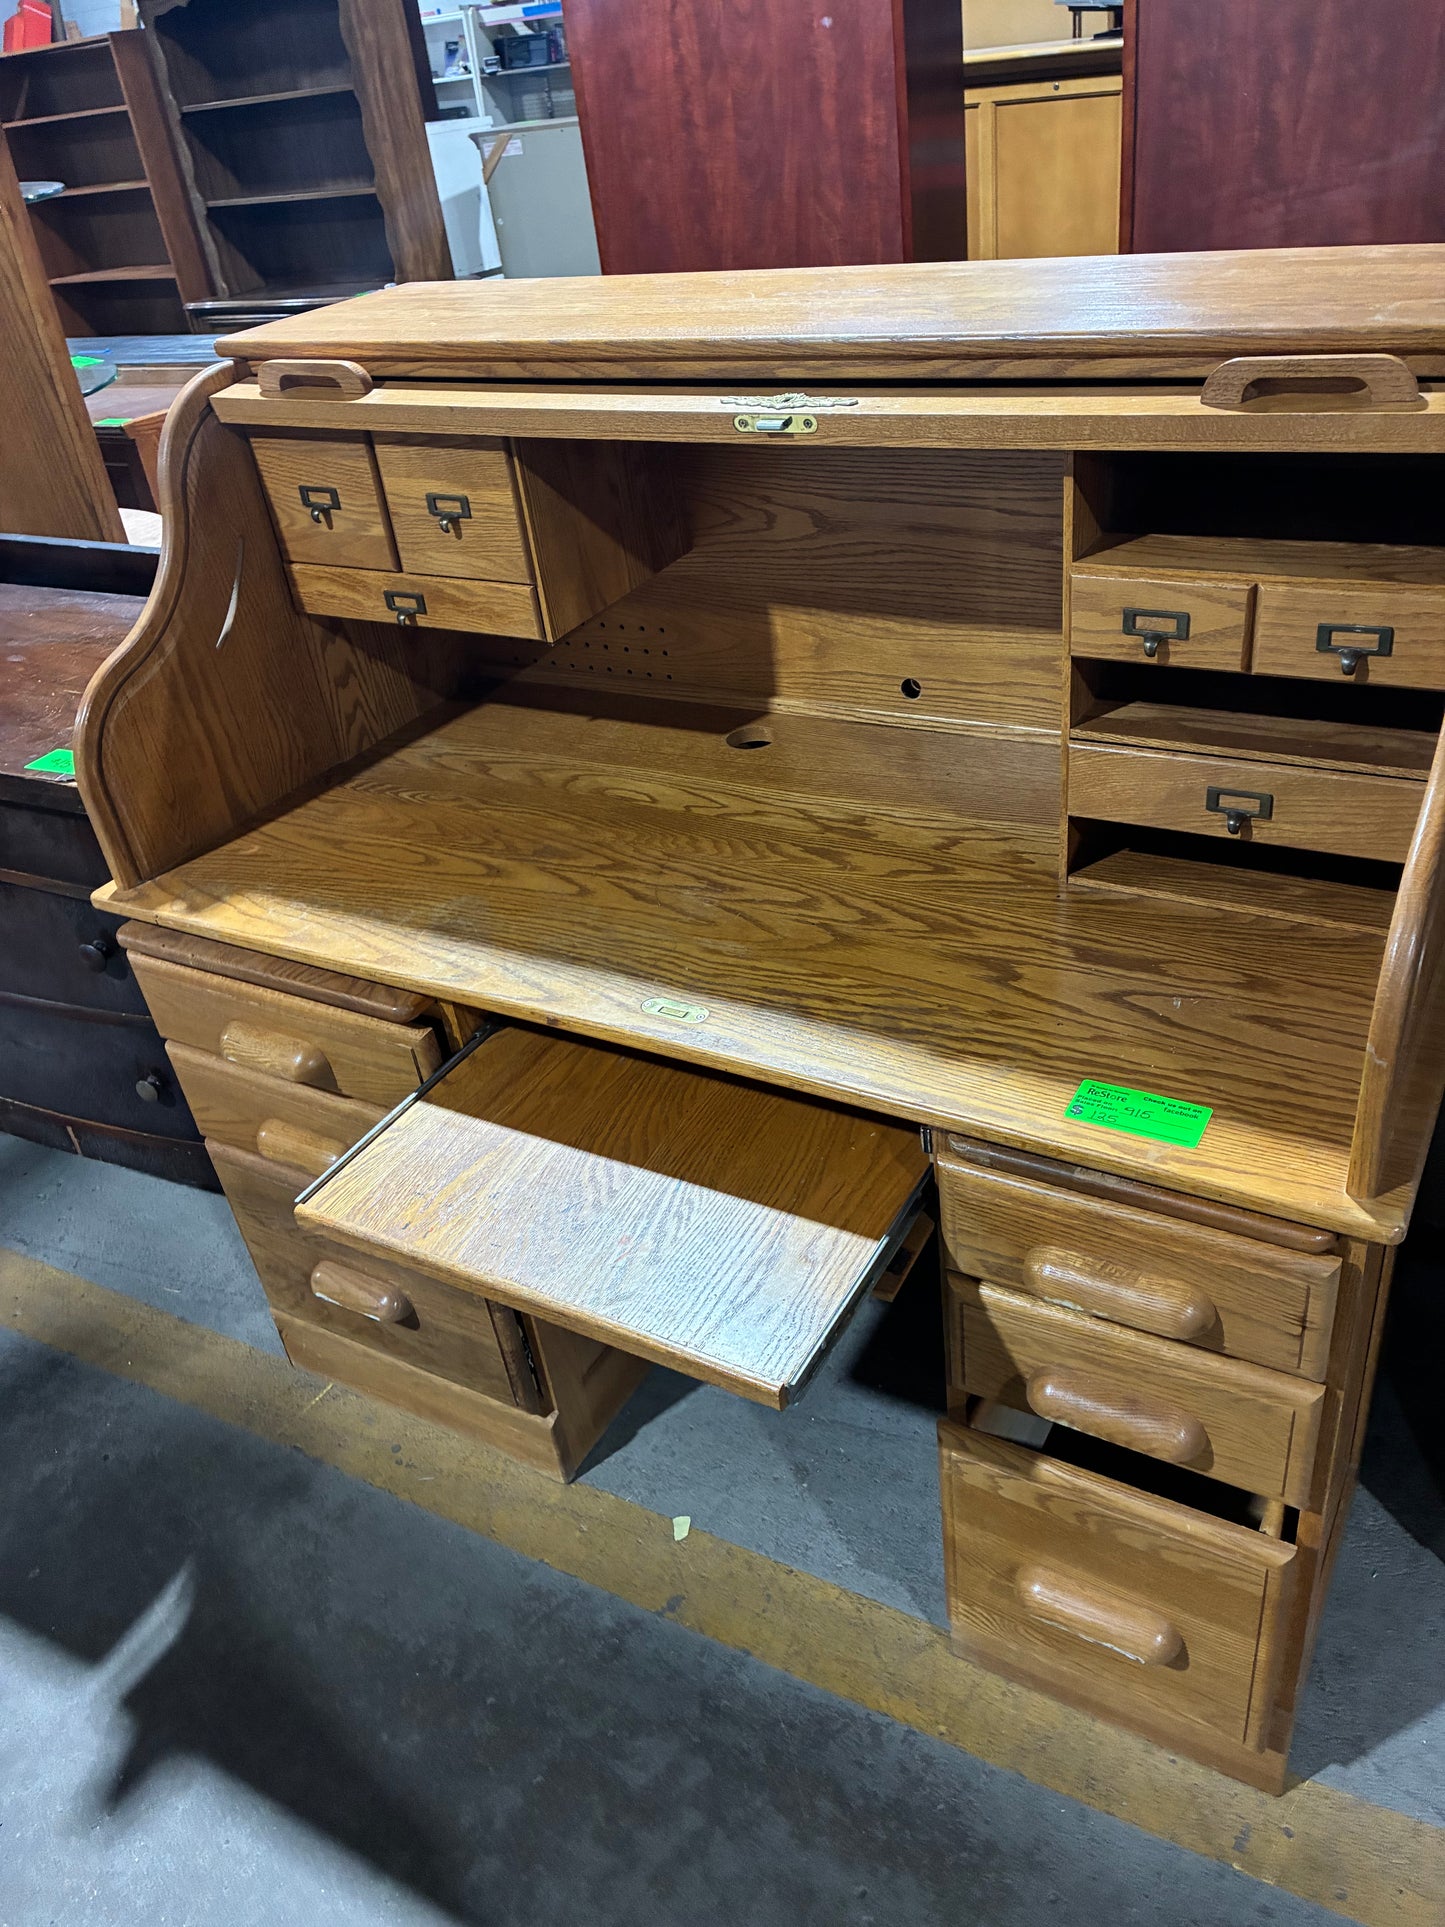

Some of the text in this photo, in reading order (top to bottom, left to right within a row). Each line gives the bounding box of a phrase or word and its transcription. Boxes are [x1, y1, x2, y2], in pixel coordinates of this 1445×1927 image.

[1087, 1088, 1127, 1102] ReStore
[1143, 1096, 1166, 1105] Check
[1163, 1107, 1199, 1119] facebook
